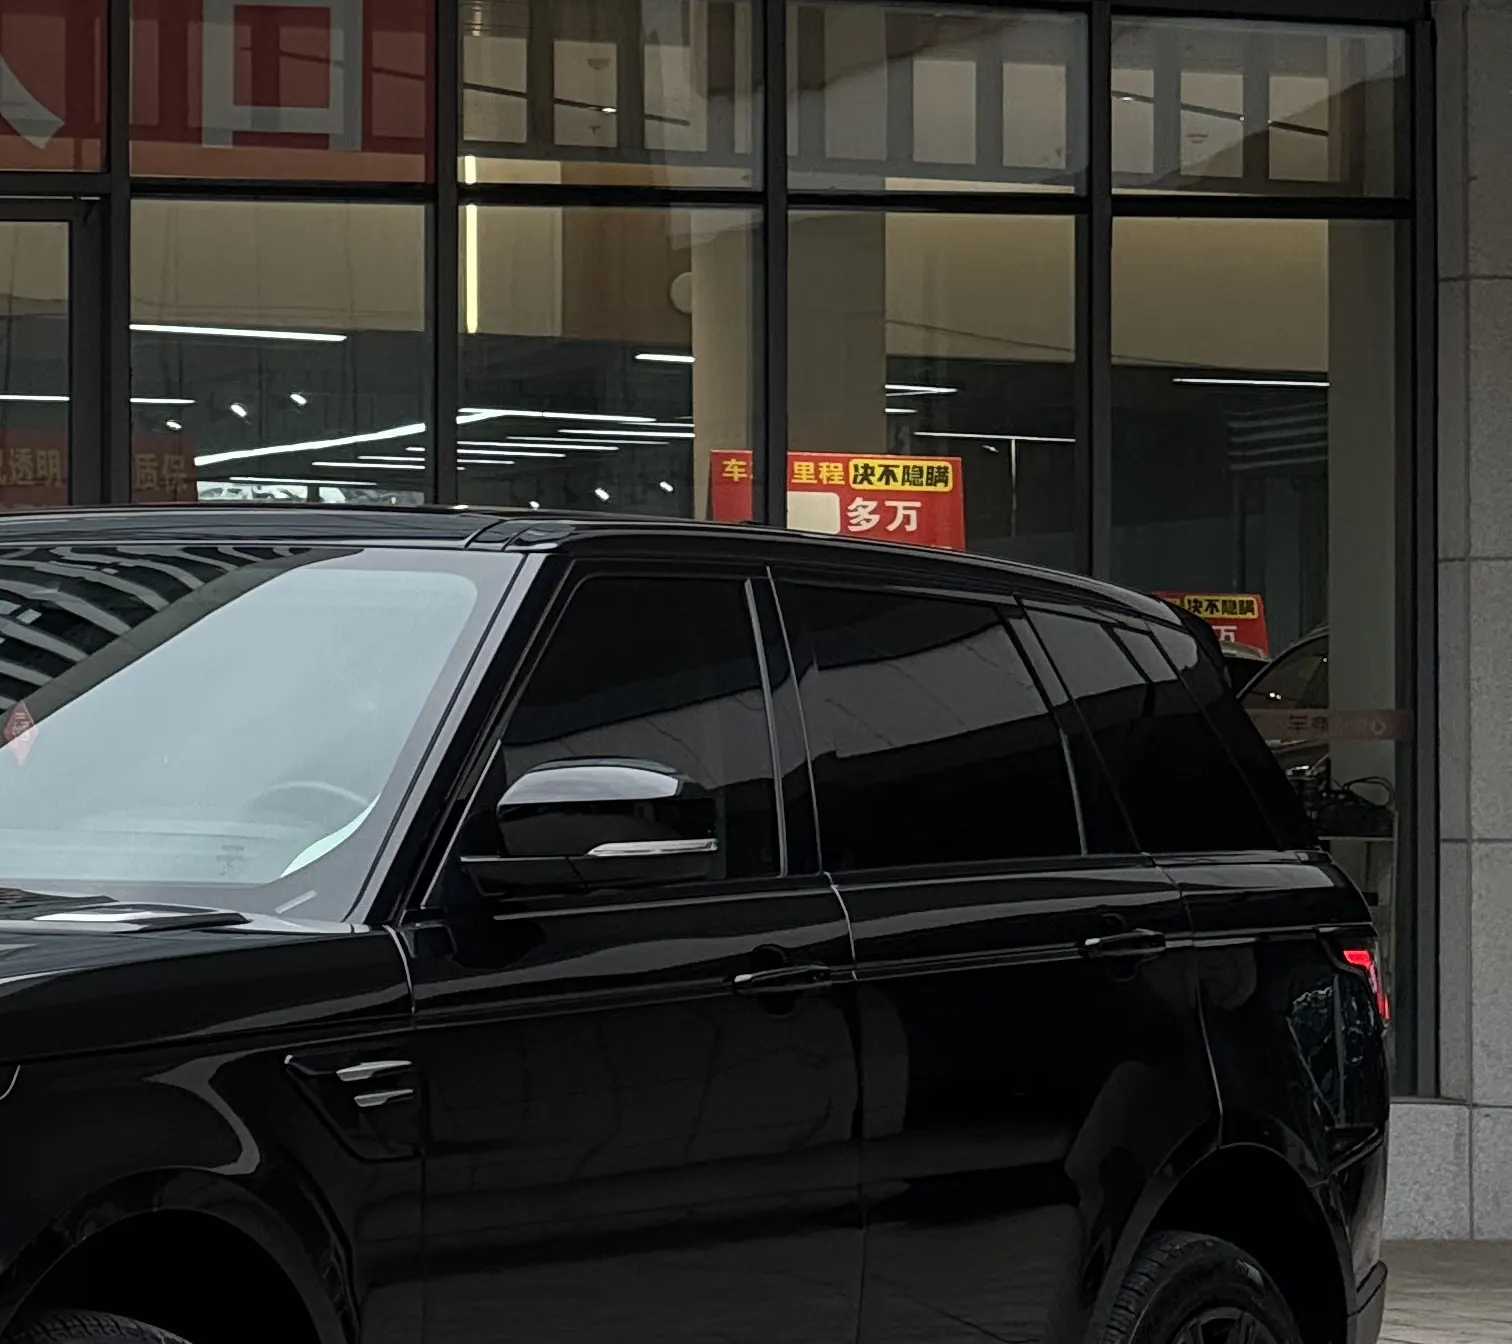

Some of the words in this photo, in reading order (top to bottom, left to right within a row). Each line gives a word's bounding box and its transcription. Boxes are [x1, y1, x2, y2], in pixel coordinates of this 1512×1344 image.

[131, 452, 189, 493] 质保
[721, 458, 753, 482] 车
[852, 463, 950, 489] 决不隐瞒
[846, 495, 922, 533] 多万
